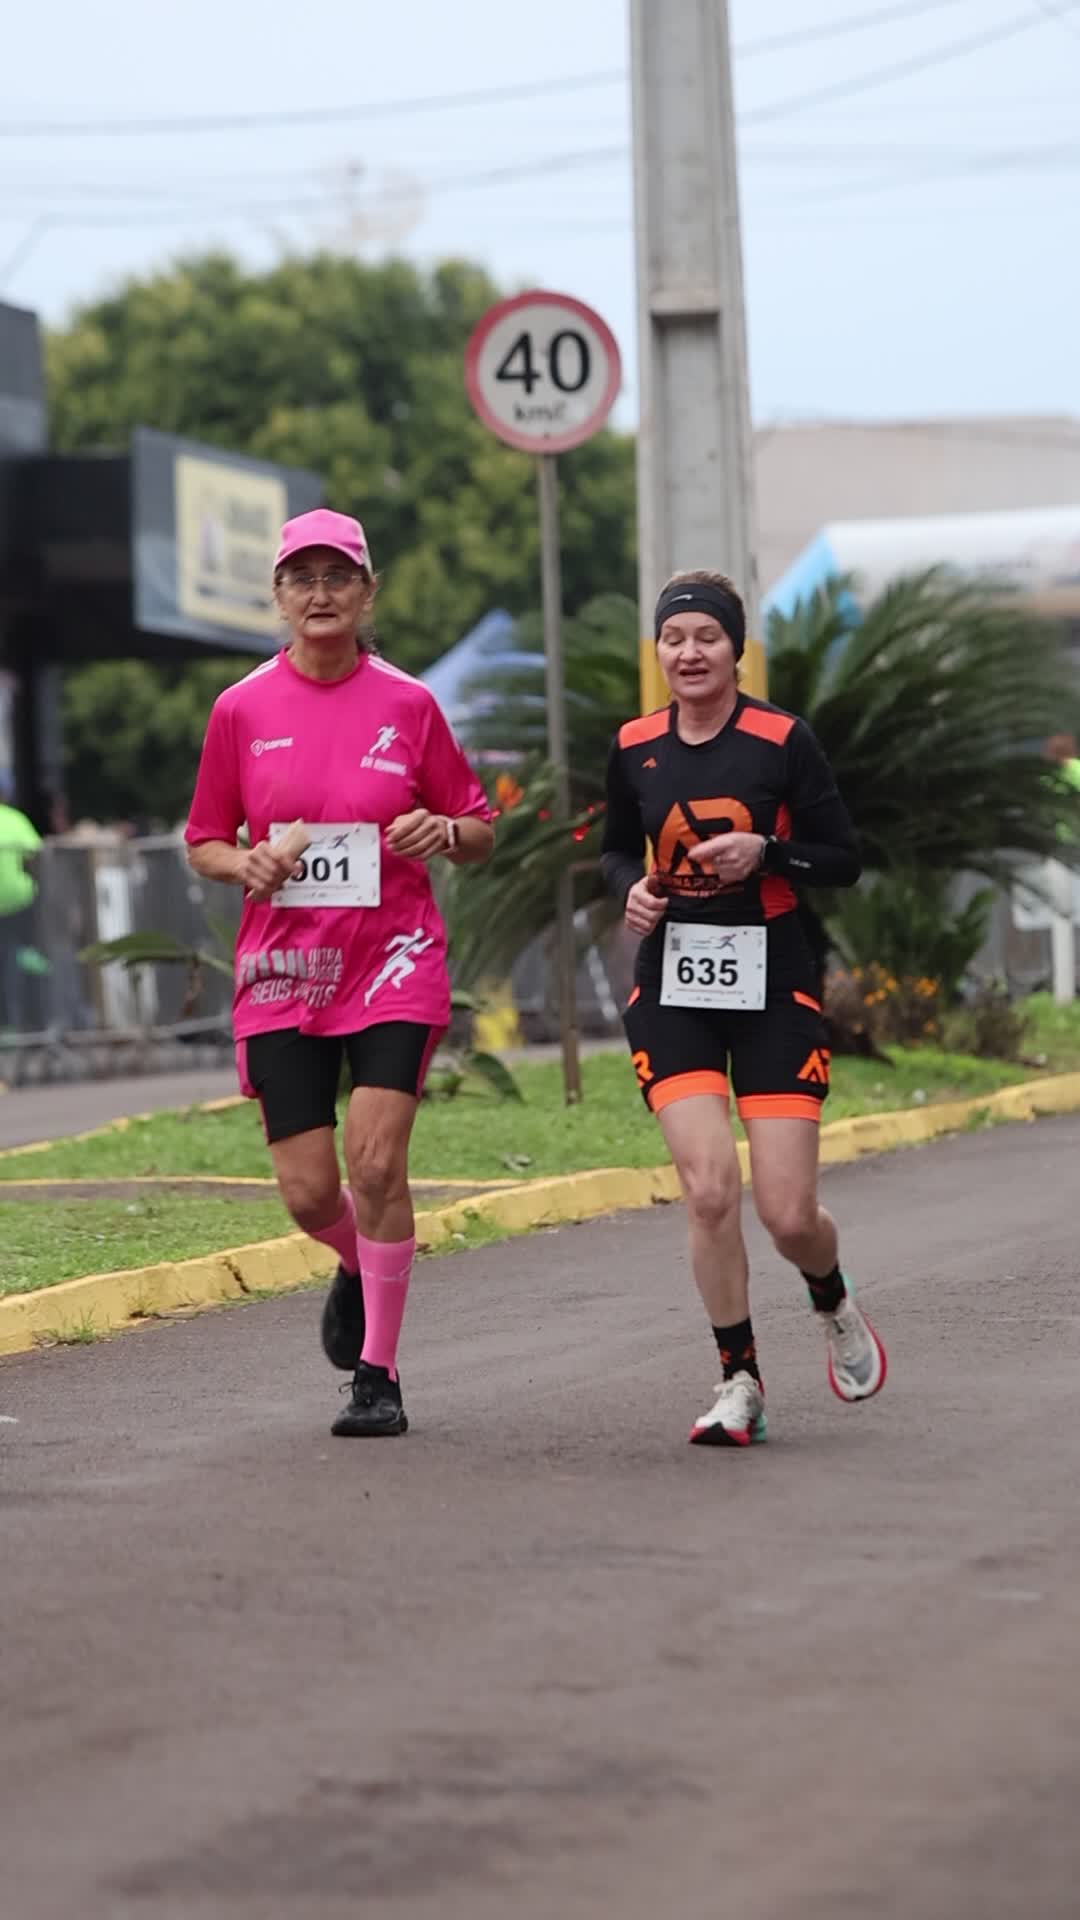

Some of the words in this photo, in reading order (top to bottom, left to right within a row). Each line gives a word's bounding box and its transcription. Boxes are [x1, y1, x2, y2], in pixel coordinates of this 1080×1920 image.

[495, 330, 590, 395] 40
[677, 956, 739, 987] 635
[249, 977, 294, 1007] SEUS
